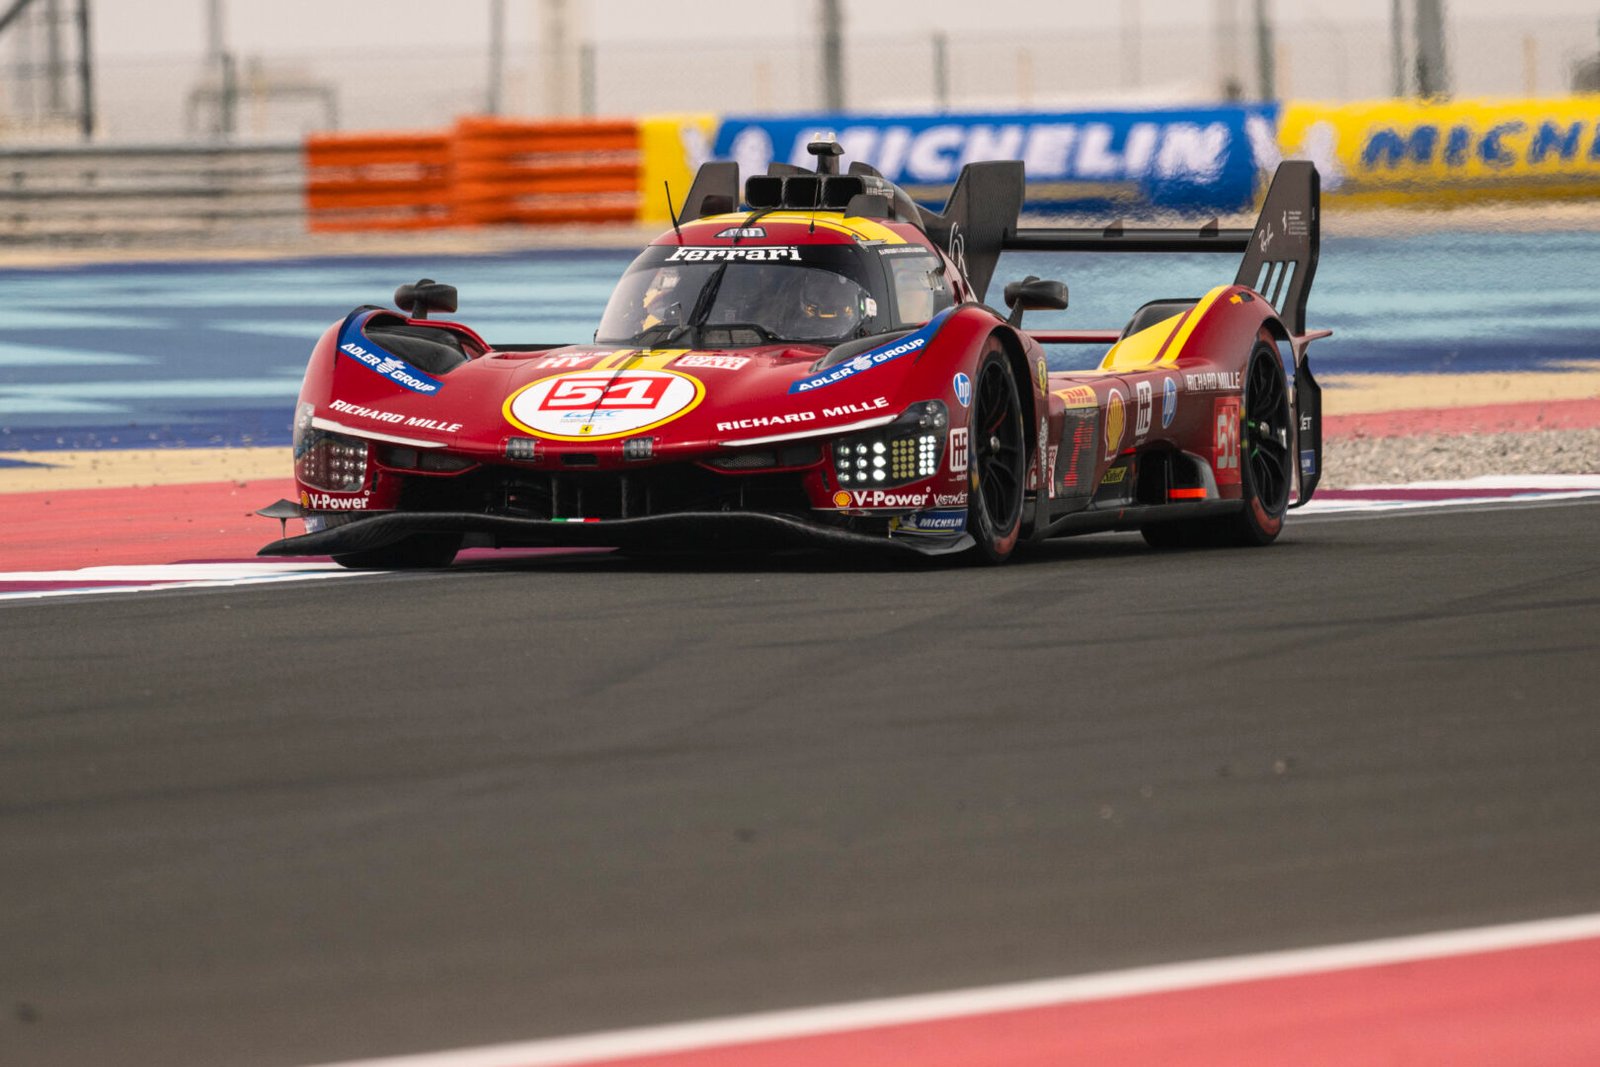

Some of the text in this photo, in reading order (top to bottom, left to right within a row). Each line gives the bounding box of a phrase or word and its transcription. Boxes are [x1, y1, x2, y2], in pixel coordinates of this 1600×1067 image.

[791, 121, 1230, 181] MICHELIN
[664, 246, 802, 262] Ferrari
[341, 343, 436, 392] ADLER GROUP
[798, 338, 925, 391] ADLER GROUP
[547, 379, 655, 407] 51
[1186, 371, 1241, 391] RICHARD MILLE
[329, 399, 463, 433] RICHARD MILLE
[717, 396, 889, 432] RICHARD MILLE
[1216, 413, 1238, 469] 51
[309, 493, 369, 509] V-Power
[853, 490, 928, 507] V-Power
[919, 517, 963, 528] MICHELIN
